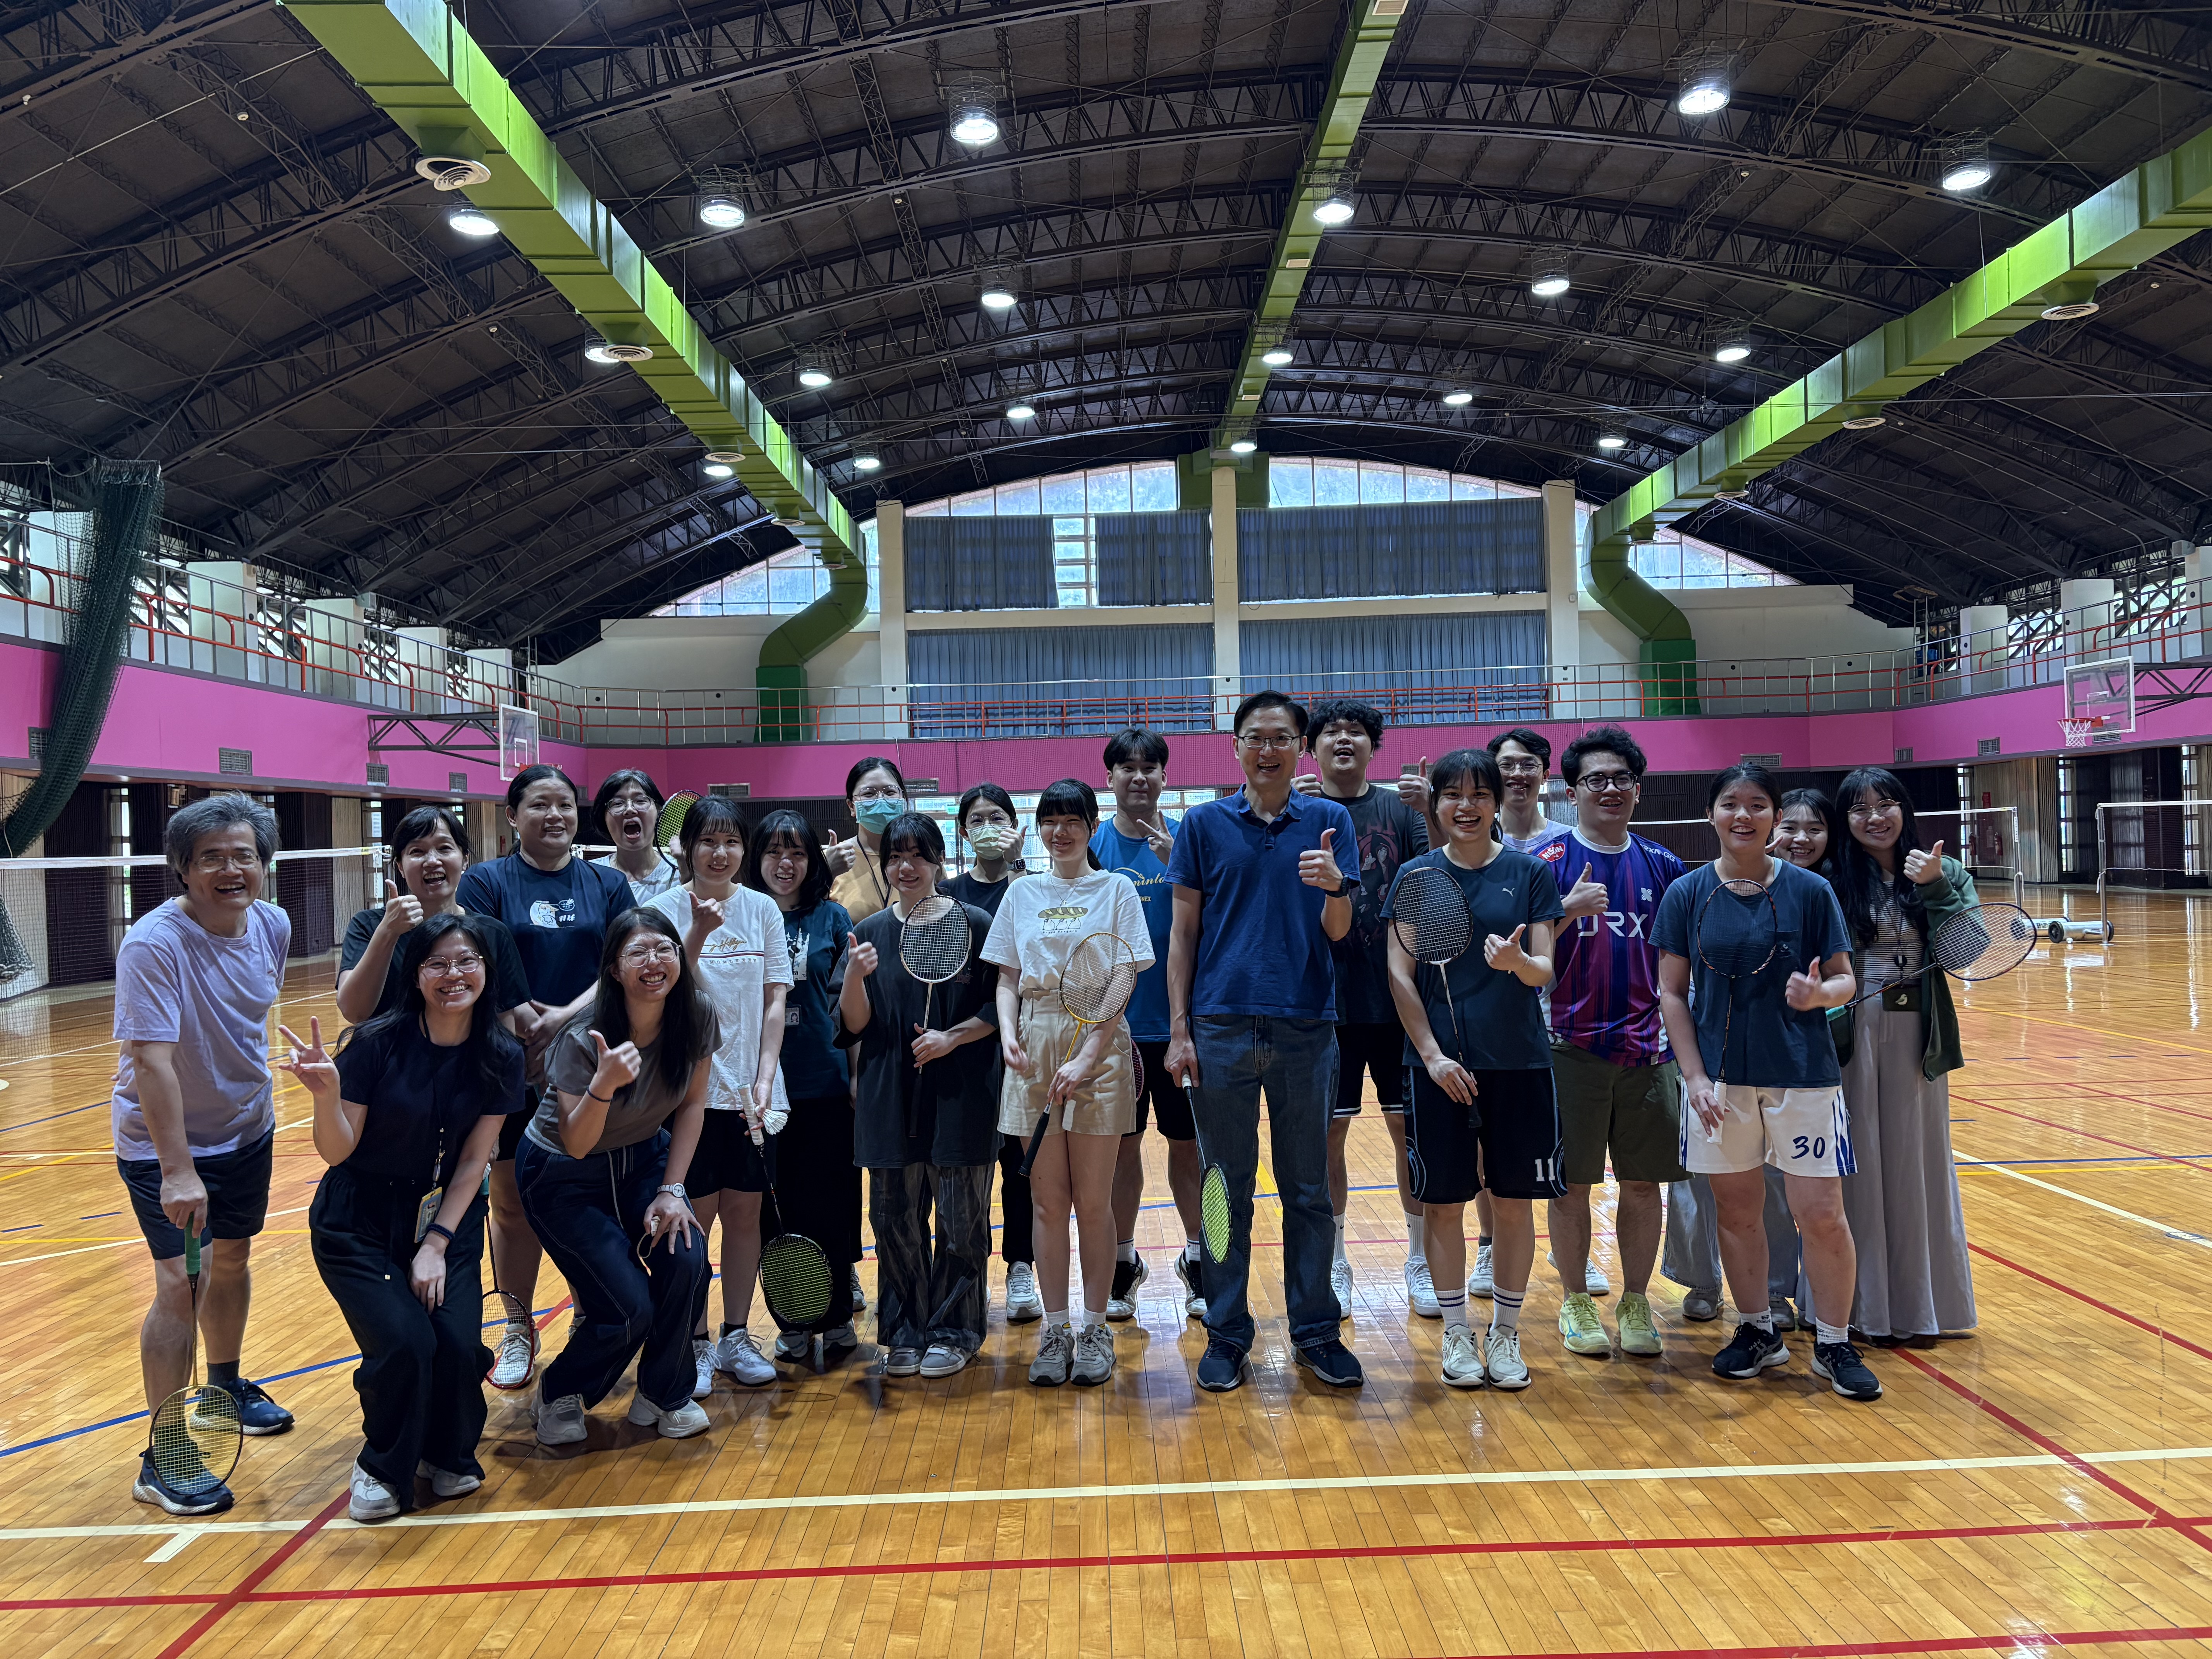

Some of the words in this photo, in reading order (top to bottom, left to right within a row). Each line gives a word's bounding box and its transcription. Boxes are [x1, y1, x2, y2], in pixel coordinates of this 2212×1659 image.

[1576, 911, 1649, 939] DRX
[1791, 1136, 1826, 1159] 30
[1535, 1158, 1556, 1182] 11
